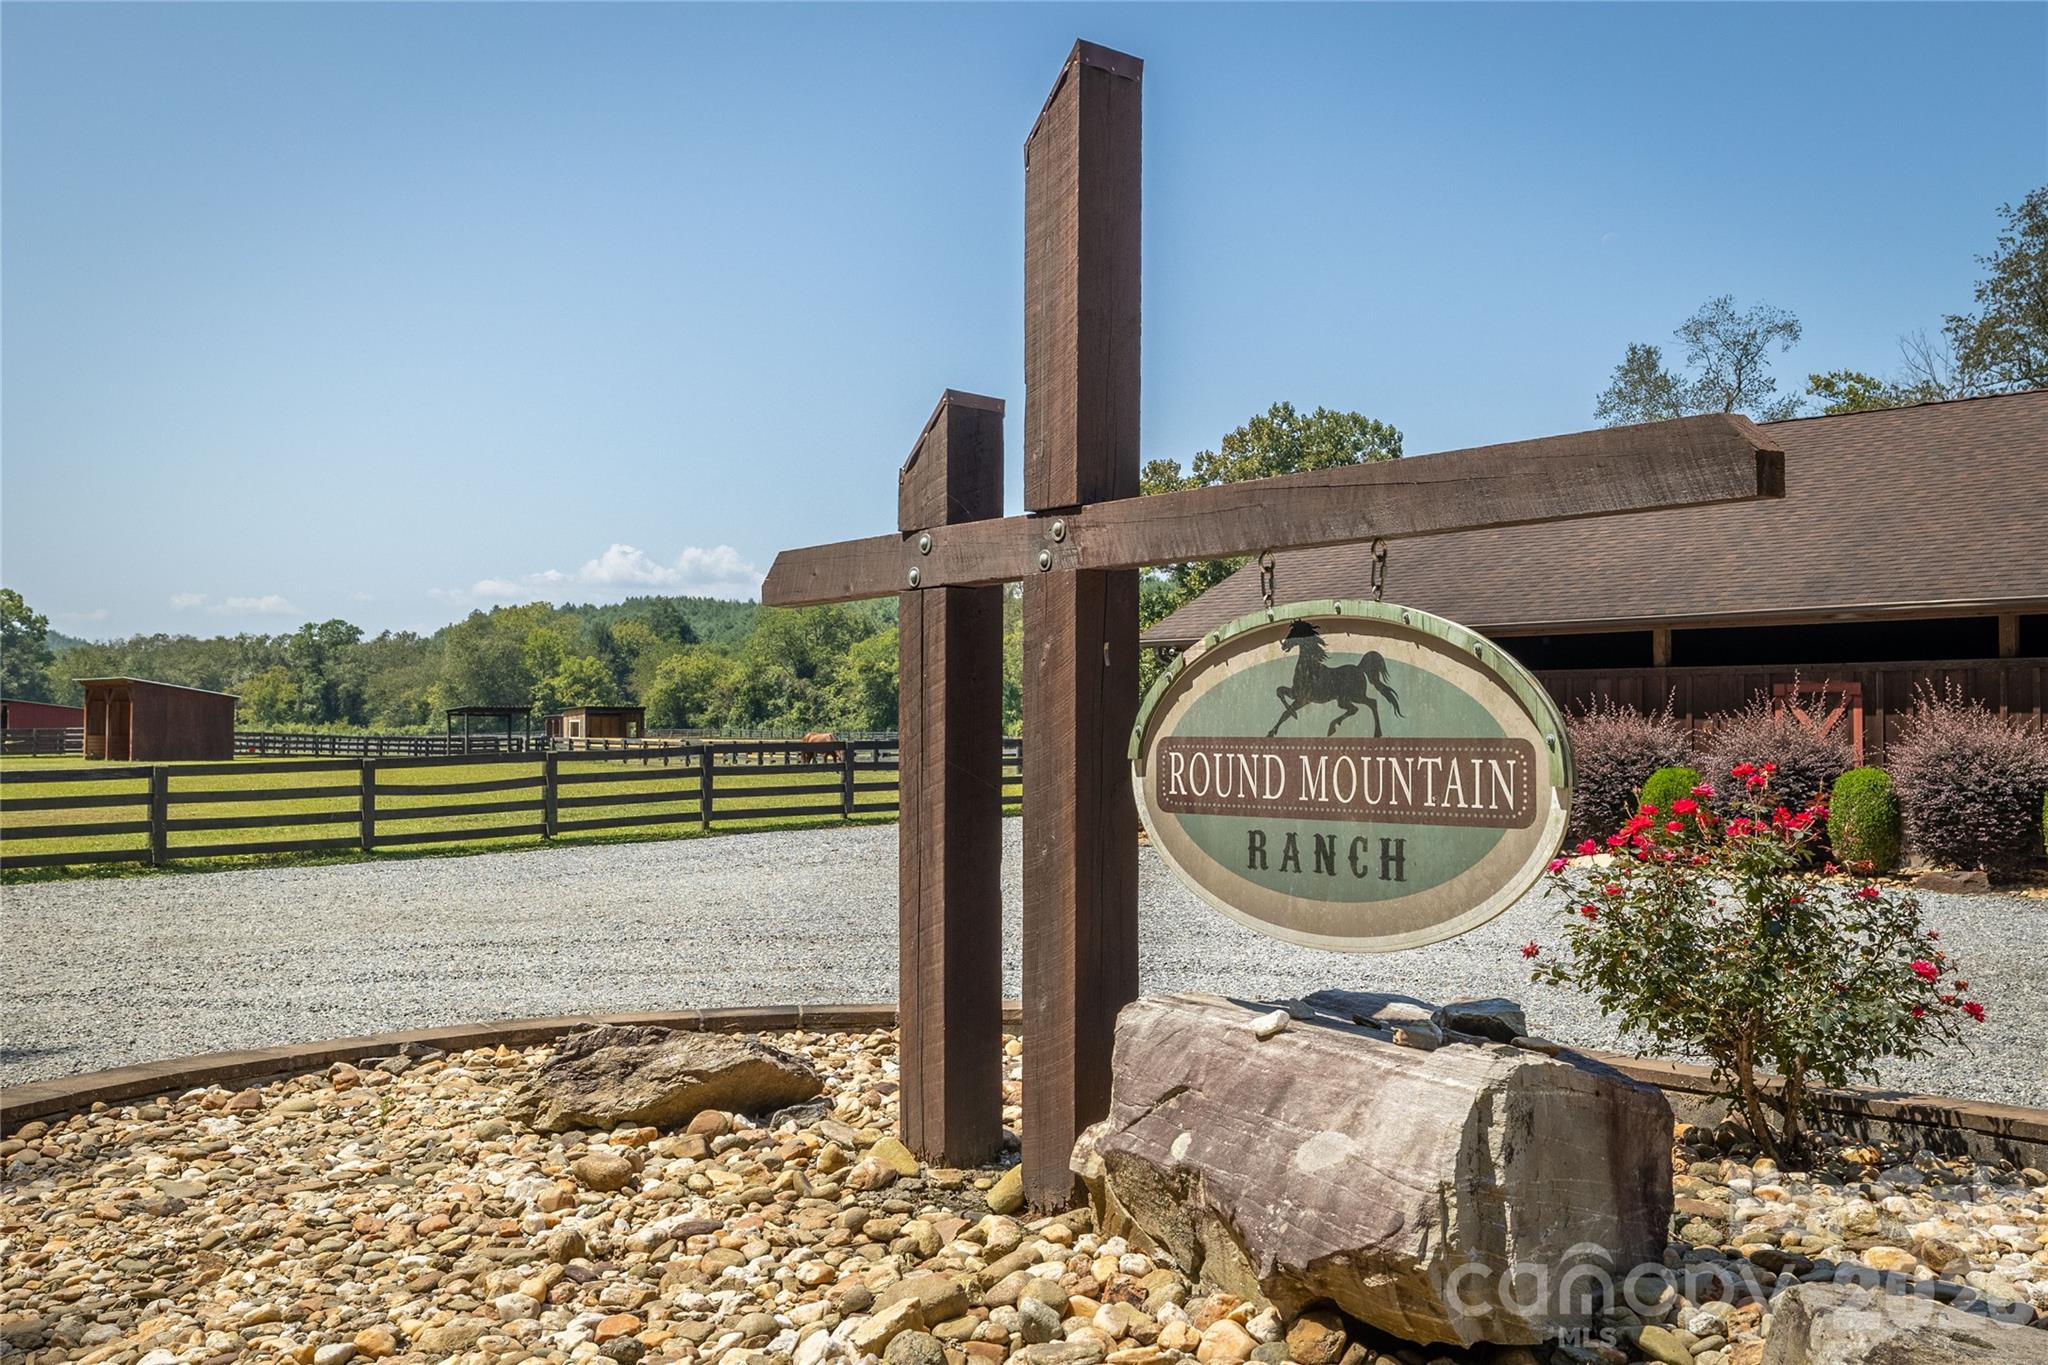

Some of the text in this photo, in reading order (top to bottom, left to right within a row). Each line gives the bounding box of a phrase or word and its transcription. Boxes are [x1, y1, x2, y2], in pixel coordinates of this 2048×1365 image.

[1168, 752, 1517, 810] ROUND MOUNTAIN
[1247, 829, 1407, 882] RANCH
